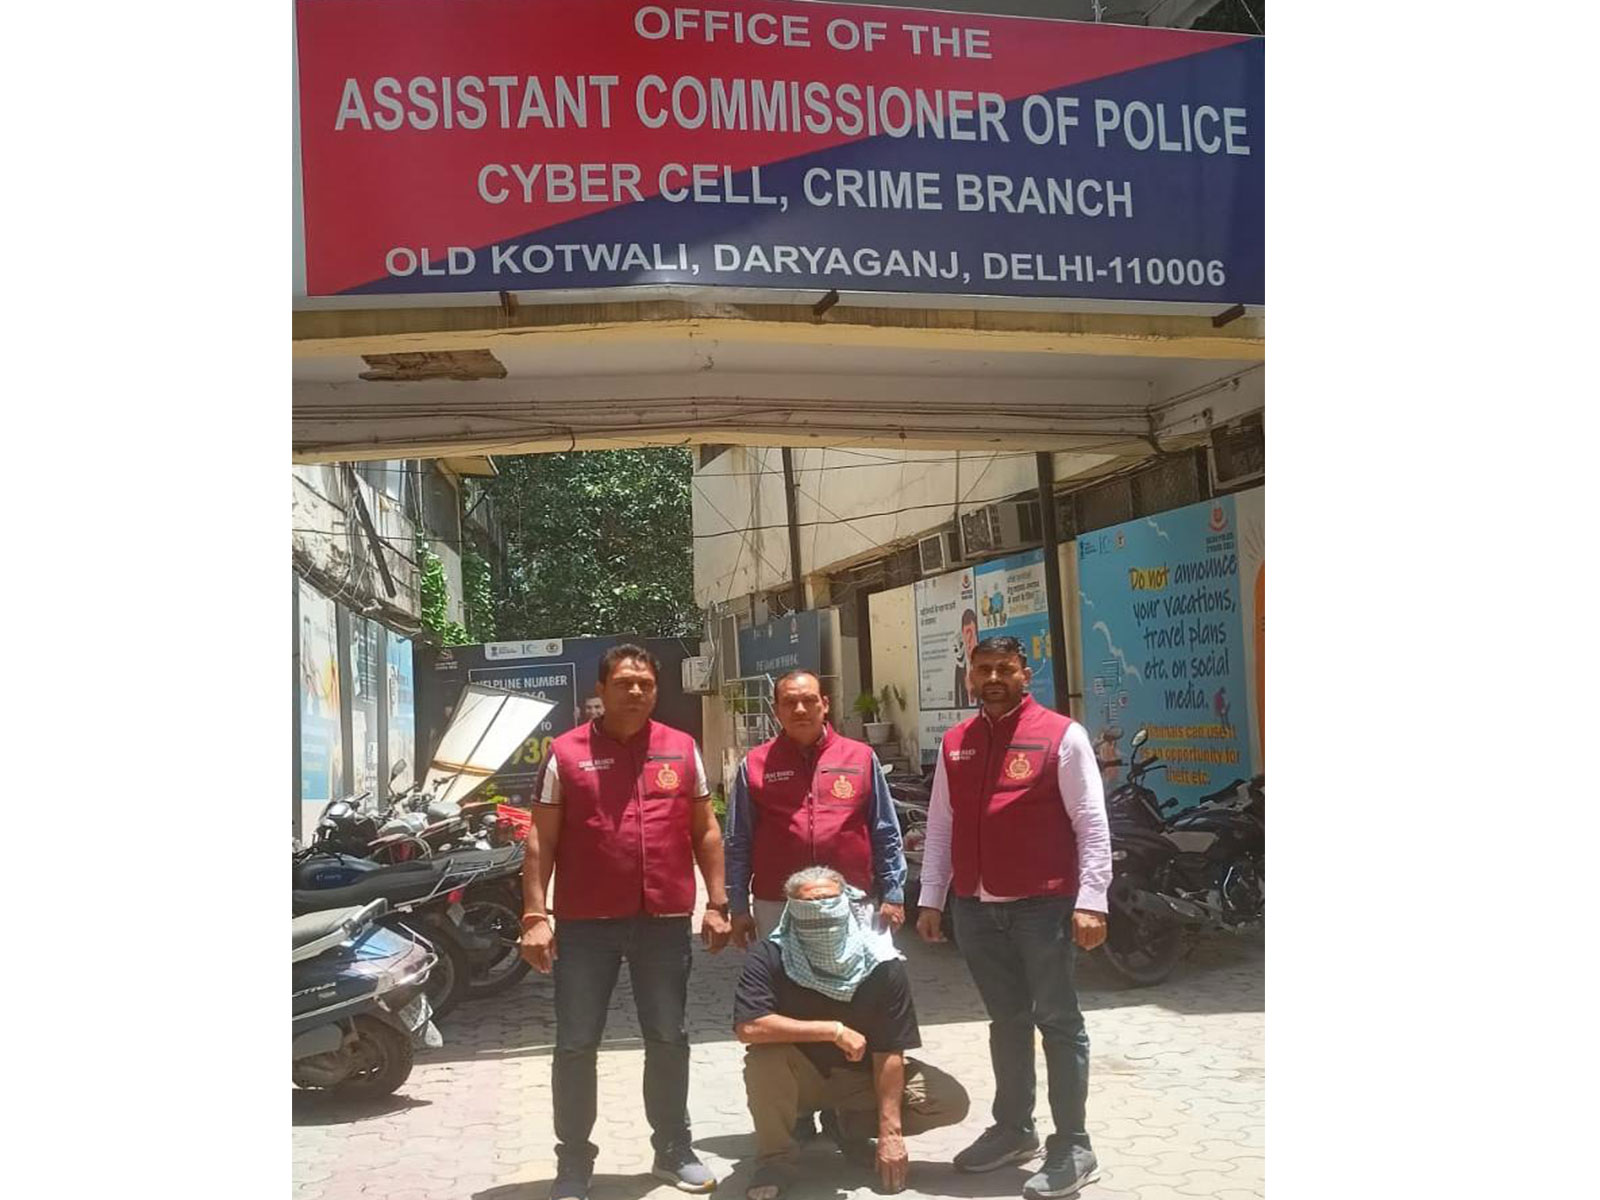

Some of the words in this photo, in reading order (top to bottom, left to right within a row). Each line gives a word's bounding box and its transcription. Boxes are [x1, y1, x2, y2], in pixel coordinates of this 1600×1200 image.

[634, 6, 812, 49] OFFICE
[826, 19, 887, 52] OF
[902, 24, 993, 60] THE
[335, 75, 619, 131] ASSISTANT
[635, 75, 1010, 143] COMMISSIONER
[1022, 94, 1080, 146] OF
[1095, 98, 1251, 155] POLICE
[477, 163, 645, 204] CYBER
[658, 163, 789, 212] CELL,
[803, 167, 944, 210] CRIME
[956, 174, 1133, 218] BRANCH
[385, 247, 476, 277] OLD
[492, 243, 701, 277] KOTWALI,
[714, 244, 971, 284] DARYAGANJ,
[983, 252, 1226, 287] DELHI-110006
[1130, 568, 1145, 590] Do
[1149, 562, 1169, 588] not
[1174, 554, 1237, 584] announce
[1133, 599, 1160, 627] your
[1163, 586, 1236, 618] vacations,
[1143, 618, 1184, 650] travel
[1188, 617, 1227, 650] plans
[524, 675, 568, 688] NUMBER
[1144, 656, 1169, 679] etc.
[1171, 659, 1187, 678] on
[1191, 648, 1230, 679] social
[1164, 681, 1209, 710] media.
